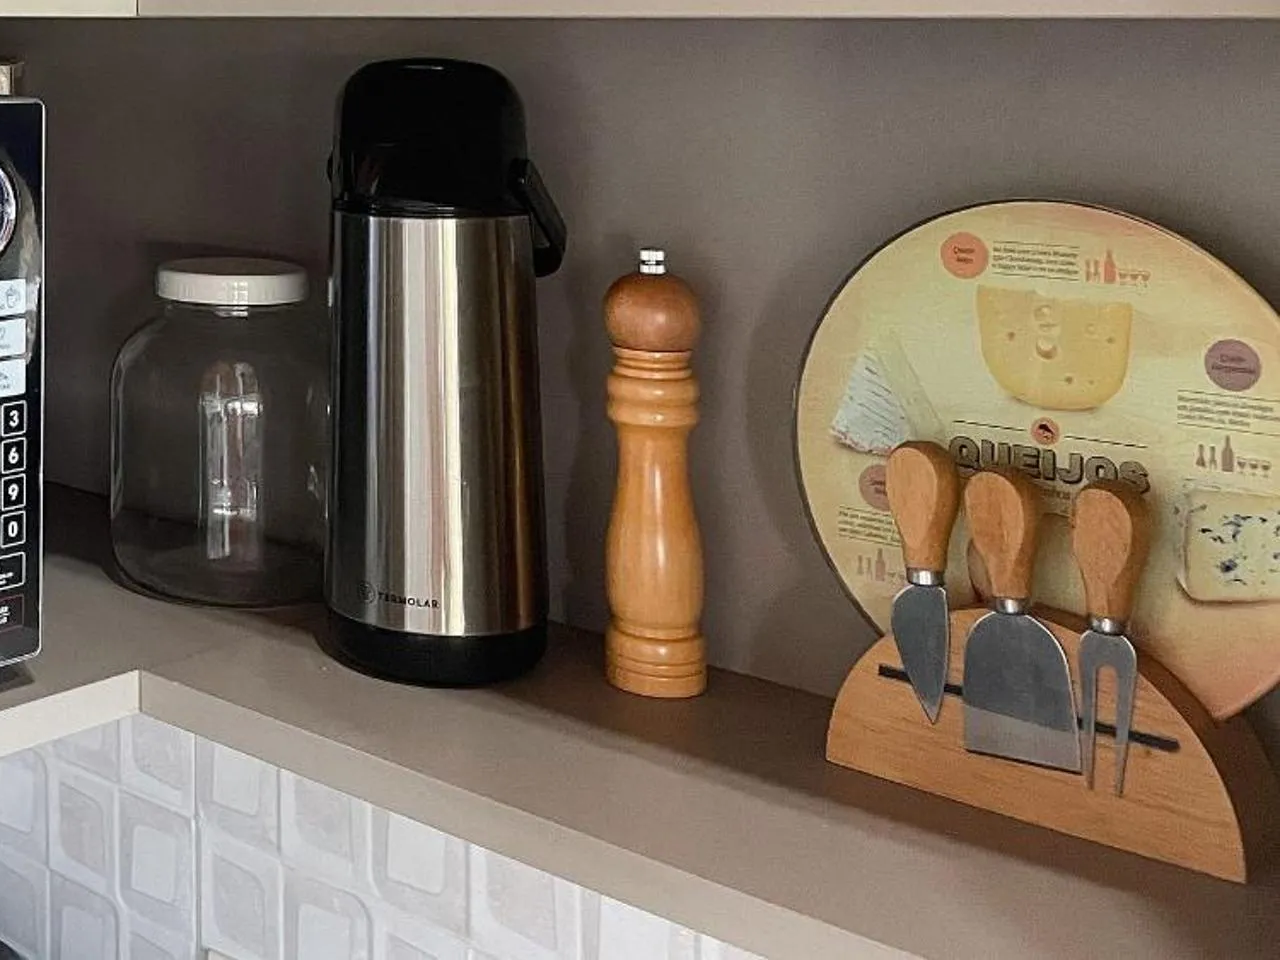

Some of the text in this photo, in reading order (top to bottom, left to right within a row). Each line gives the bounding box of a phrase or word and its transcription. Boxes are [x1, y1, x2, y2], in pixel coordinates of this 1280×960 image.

[9, 409, 20, 428] 3
[8, 446, 20, 465] 6
[949, 435, 1151, 494] QUEIJOS
[8, 482, 20, 501] 9
[7, 520, 19, 538] 0
